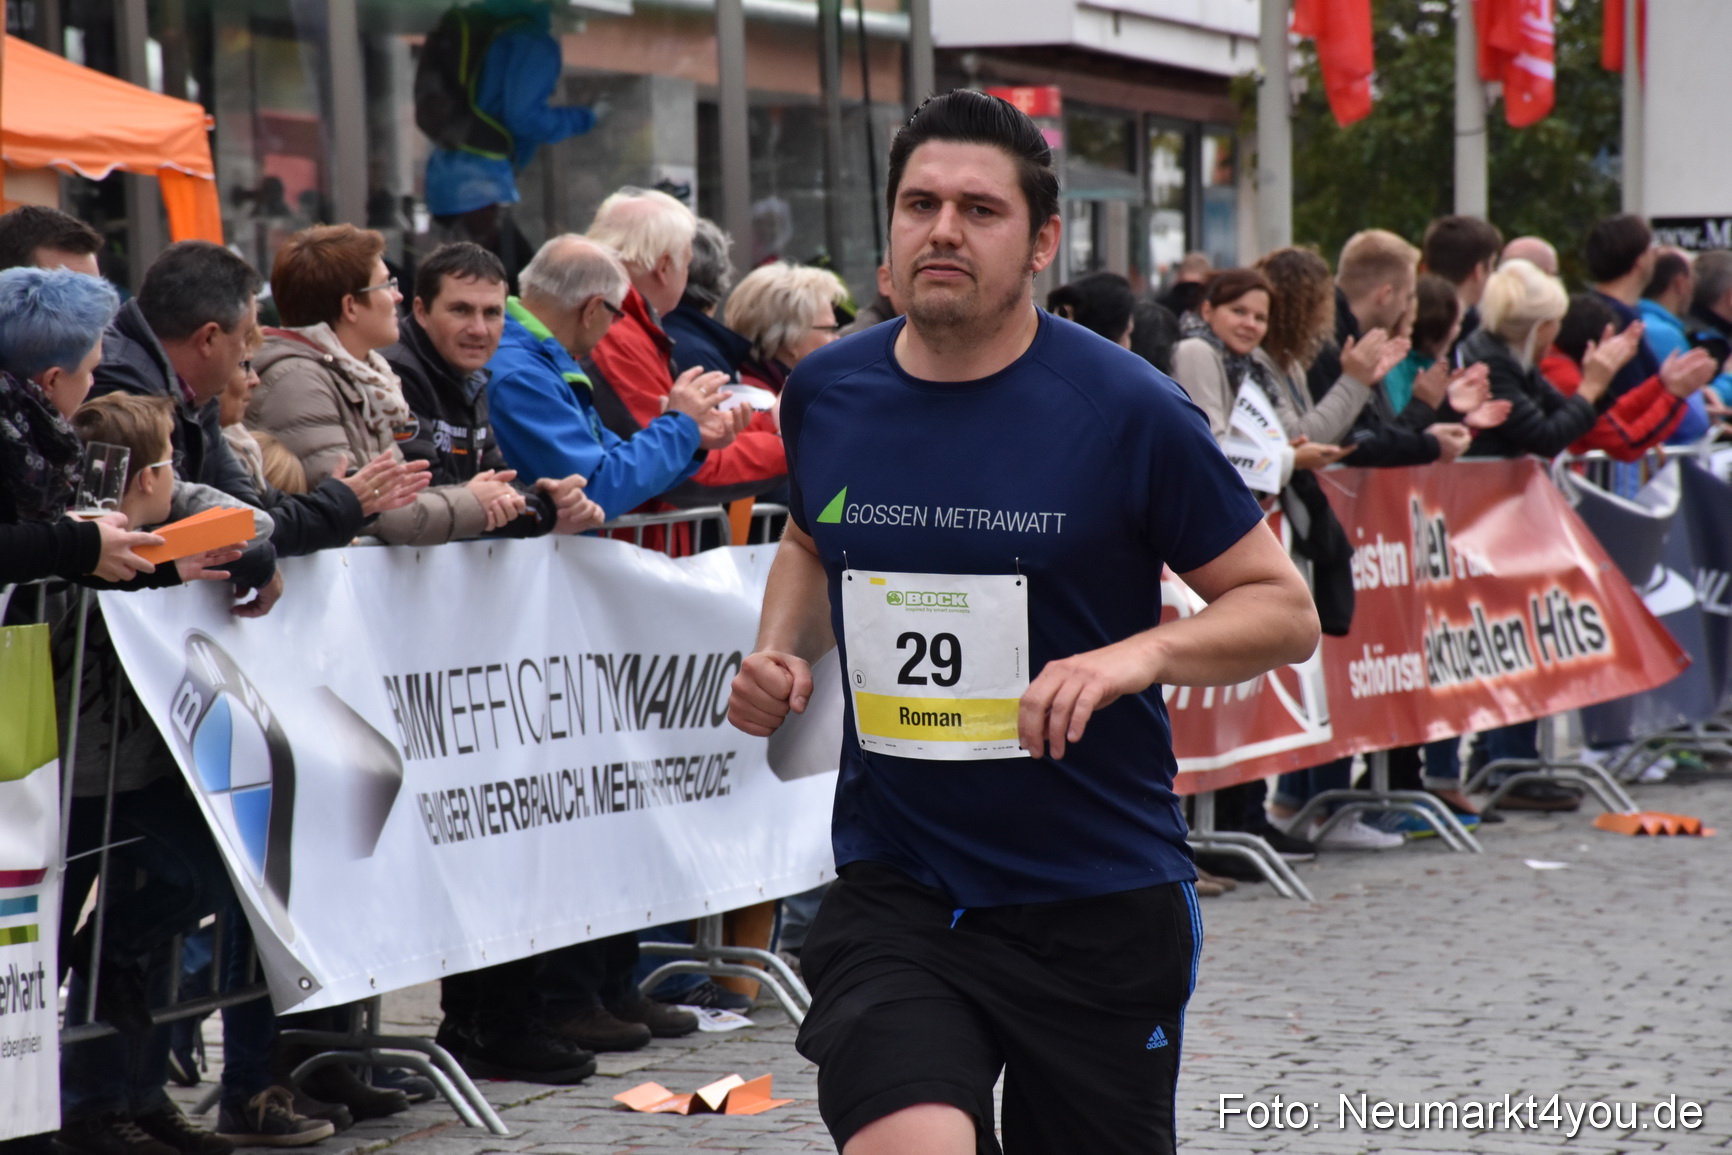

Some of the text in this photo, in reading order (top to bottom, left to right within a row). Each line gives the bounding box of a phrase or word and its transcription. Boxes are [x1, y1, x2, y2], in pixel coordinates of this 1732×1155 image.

[1226, 454, 1255, 469] wn
[846, 504, 1067, 534] GOSSEN METRAWATT
[905, 591, 969, 608] BOCK
[1529, 588, 1607, 666] Hits
[896, 631, 962, 688] 29
[171, 641, 271, 743] BMW
[383, 668, 448, 762] BMW
[899, 706, 962, 728] Roman
[471, 767, 591, 838] VERBRAUCH.
